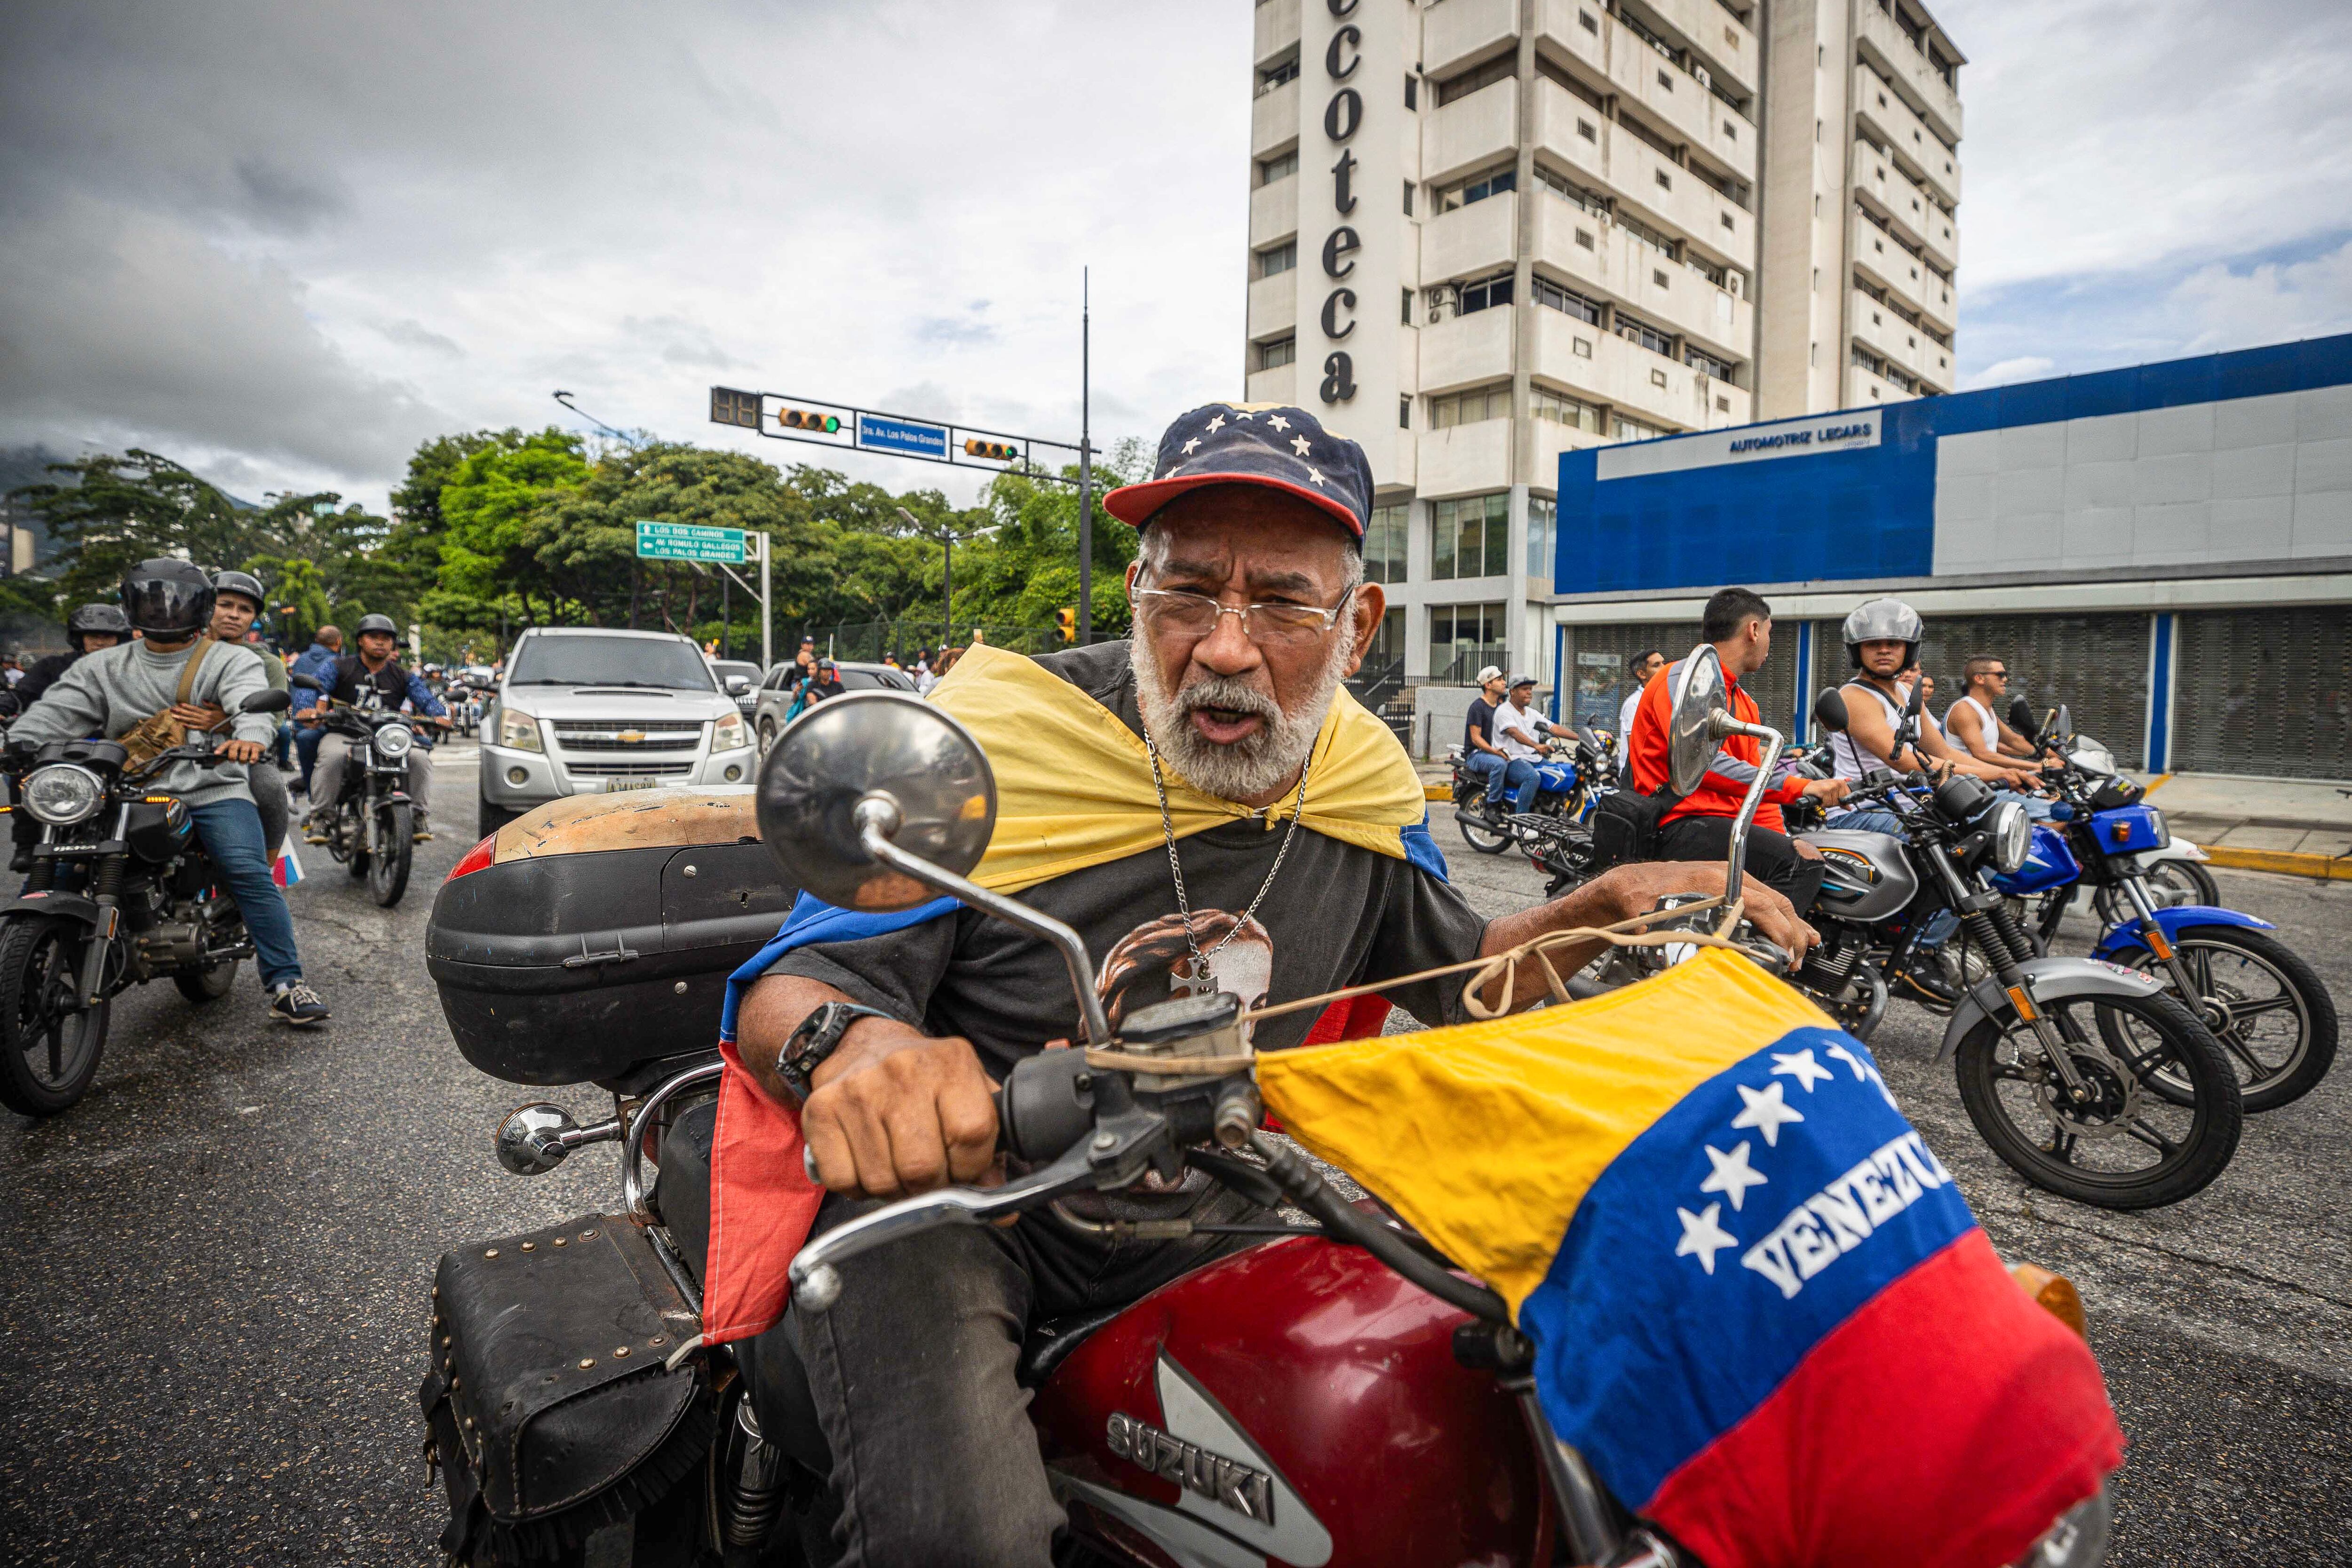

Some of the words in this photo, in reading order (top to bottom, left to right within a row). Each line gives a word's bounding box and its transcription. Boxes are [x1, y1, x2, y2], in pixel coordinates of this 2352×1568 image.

[875, 427, 885, 438] Av.
[887, 428, 899, 440] Los
[900, 430, 917, 443] Palos
[918, 433, 943, 446] Grandes
[1730, 430, 1812, 452] AUTOMOTRIZ
[1818, 423, 1872, 441] LECARS
[672, 526, 688, 535] DOS
[691, 528, 724, 538] CAMINOS
[673, 548, 697, 557] PALOS
[700, 550, 736, 559] GRANDES
[701, 541, 740, 551] GALLEGOS
[1823, 851, 1876, 872] BERA
[1106, 1411, 1274, 1527] SUZUKI
